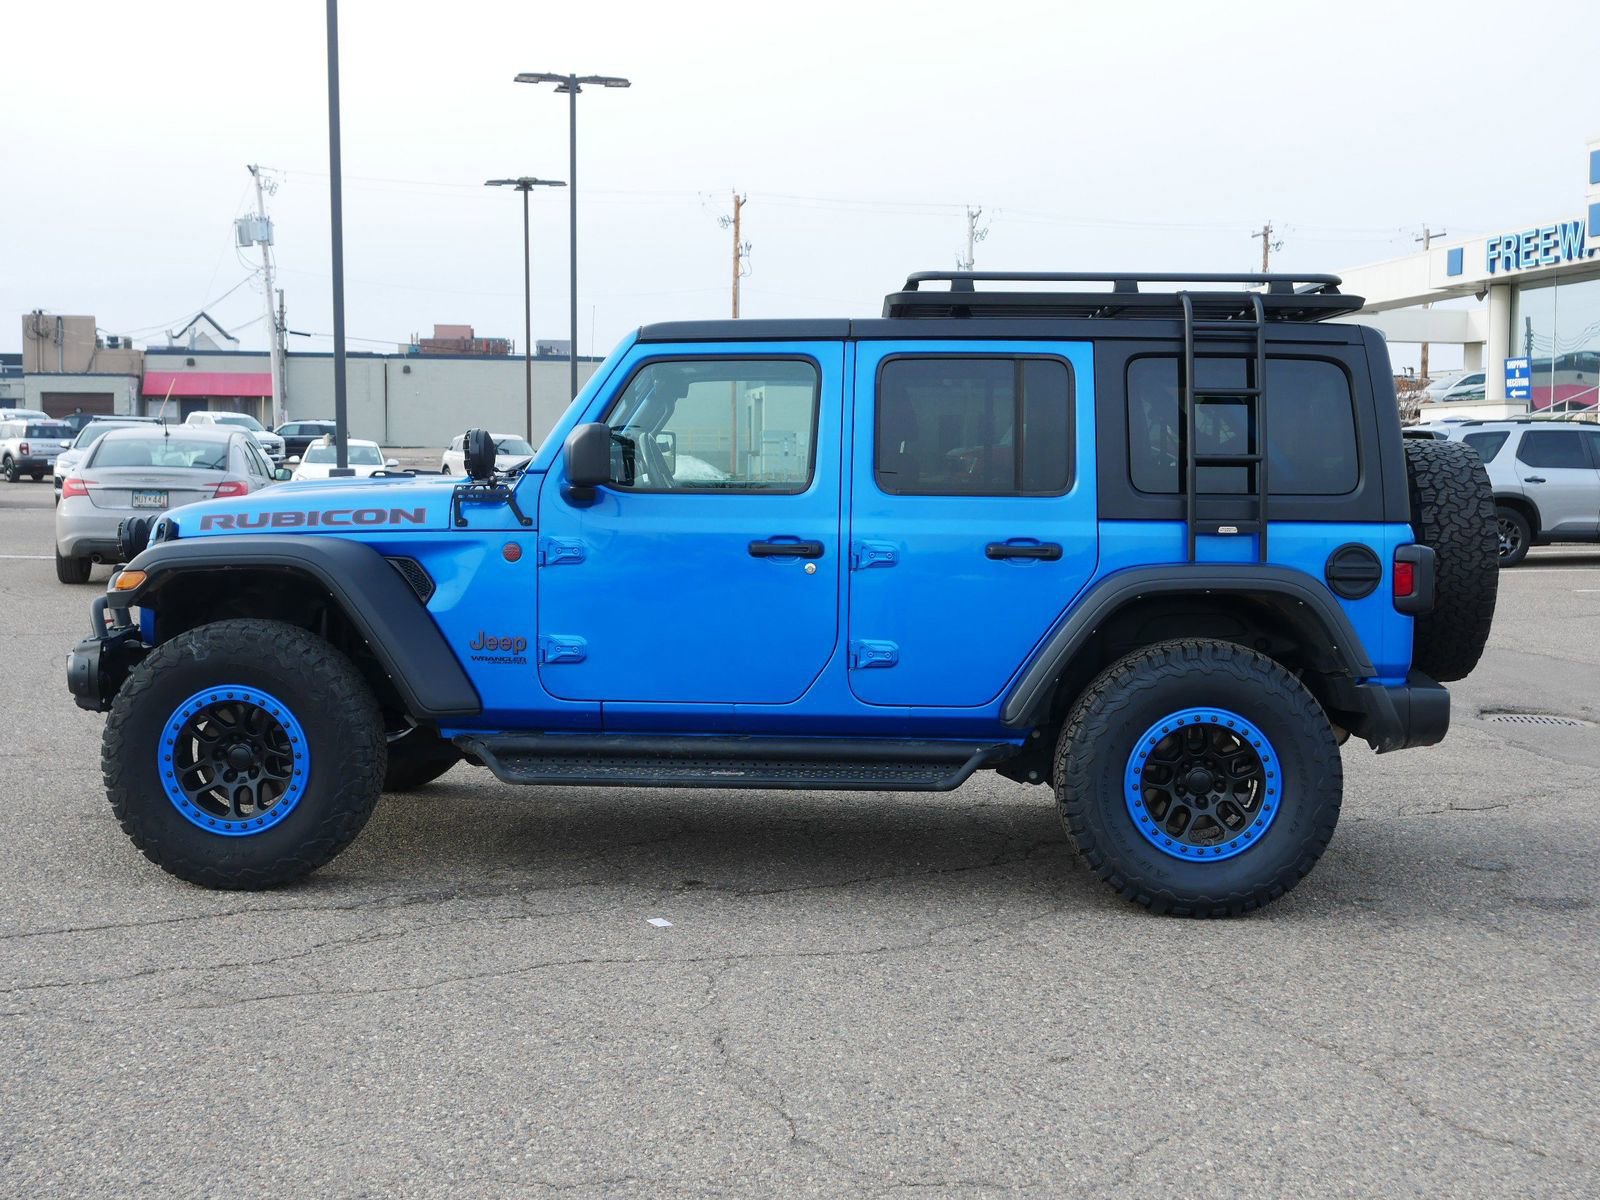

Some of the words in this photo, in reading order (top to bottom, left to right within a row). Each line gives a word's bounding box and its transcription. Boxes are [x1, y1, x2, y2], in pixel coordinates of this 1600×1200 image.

[1486, 218, 1589, 273] FREEW
[1506, 360, 1528, 369] SHIPPING
[1506, 378, 1529, 388] RECEIVING
[200, 508, 426, 531] RUBICON
[470, 629, 527, 656] Jeep
